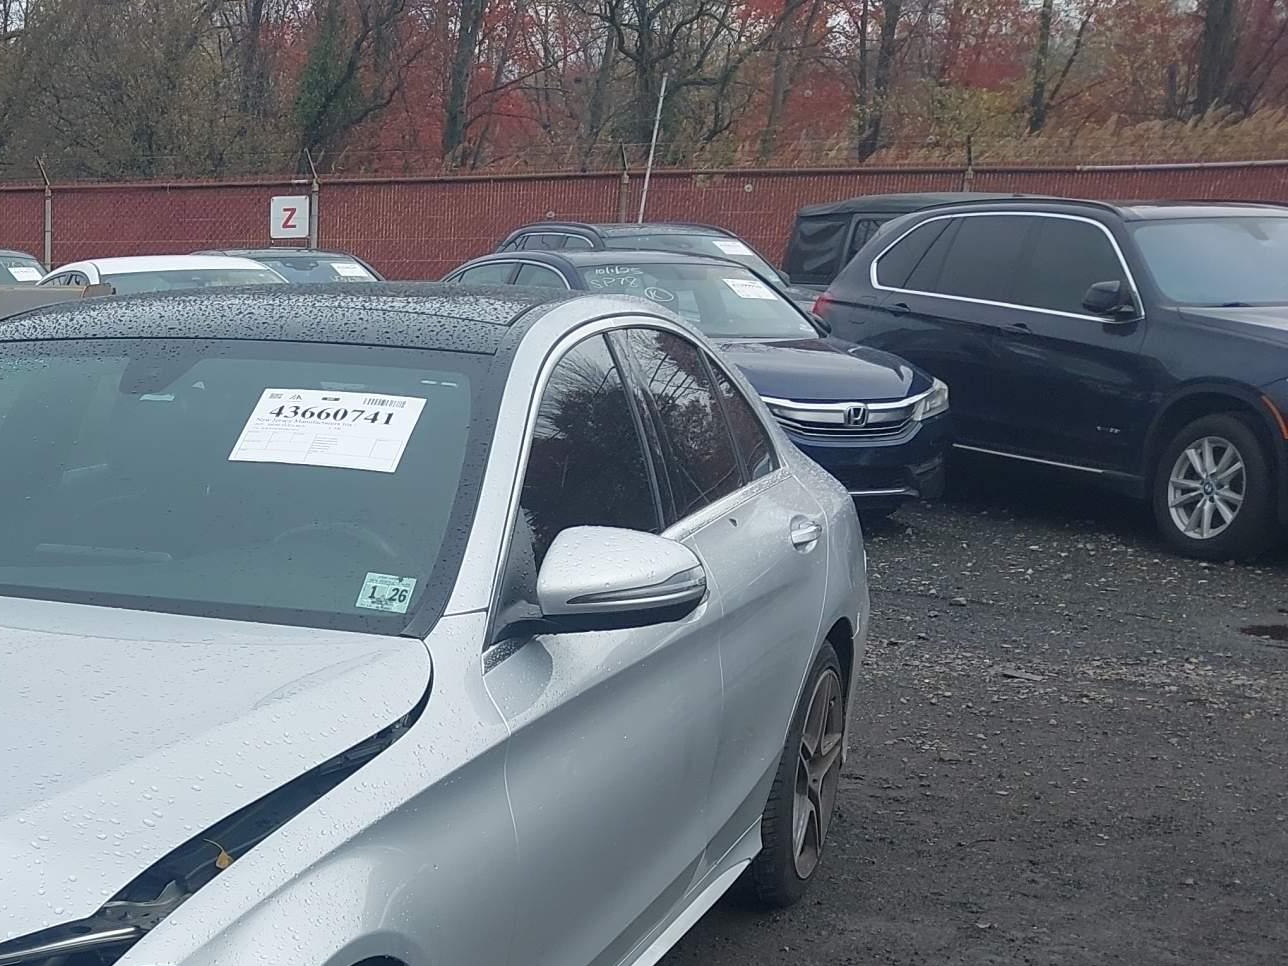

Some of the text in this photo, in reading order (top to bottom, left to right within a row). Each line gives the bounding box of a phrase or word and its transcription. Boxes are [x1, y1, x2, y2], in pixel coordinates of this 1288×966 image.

[282, 207, 297, 229] Z
[269, 404, 394, 425] 43660741
[368, 586, 409, 603] 1 26
